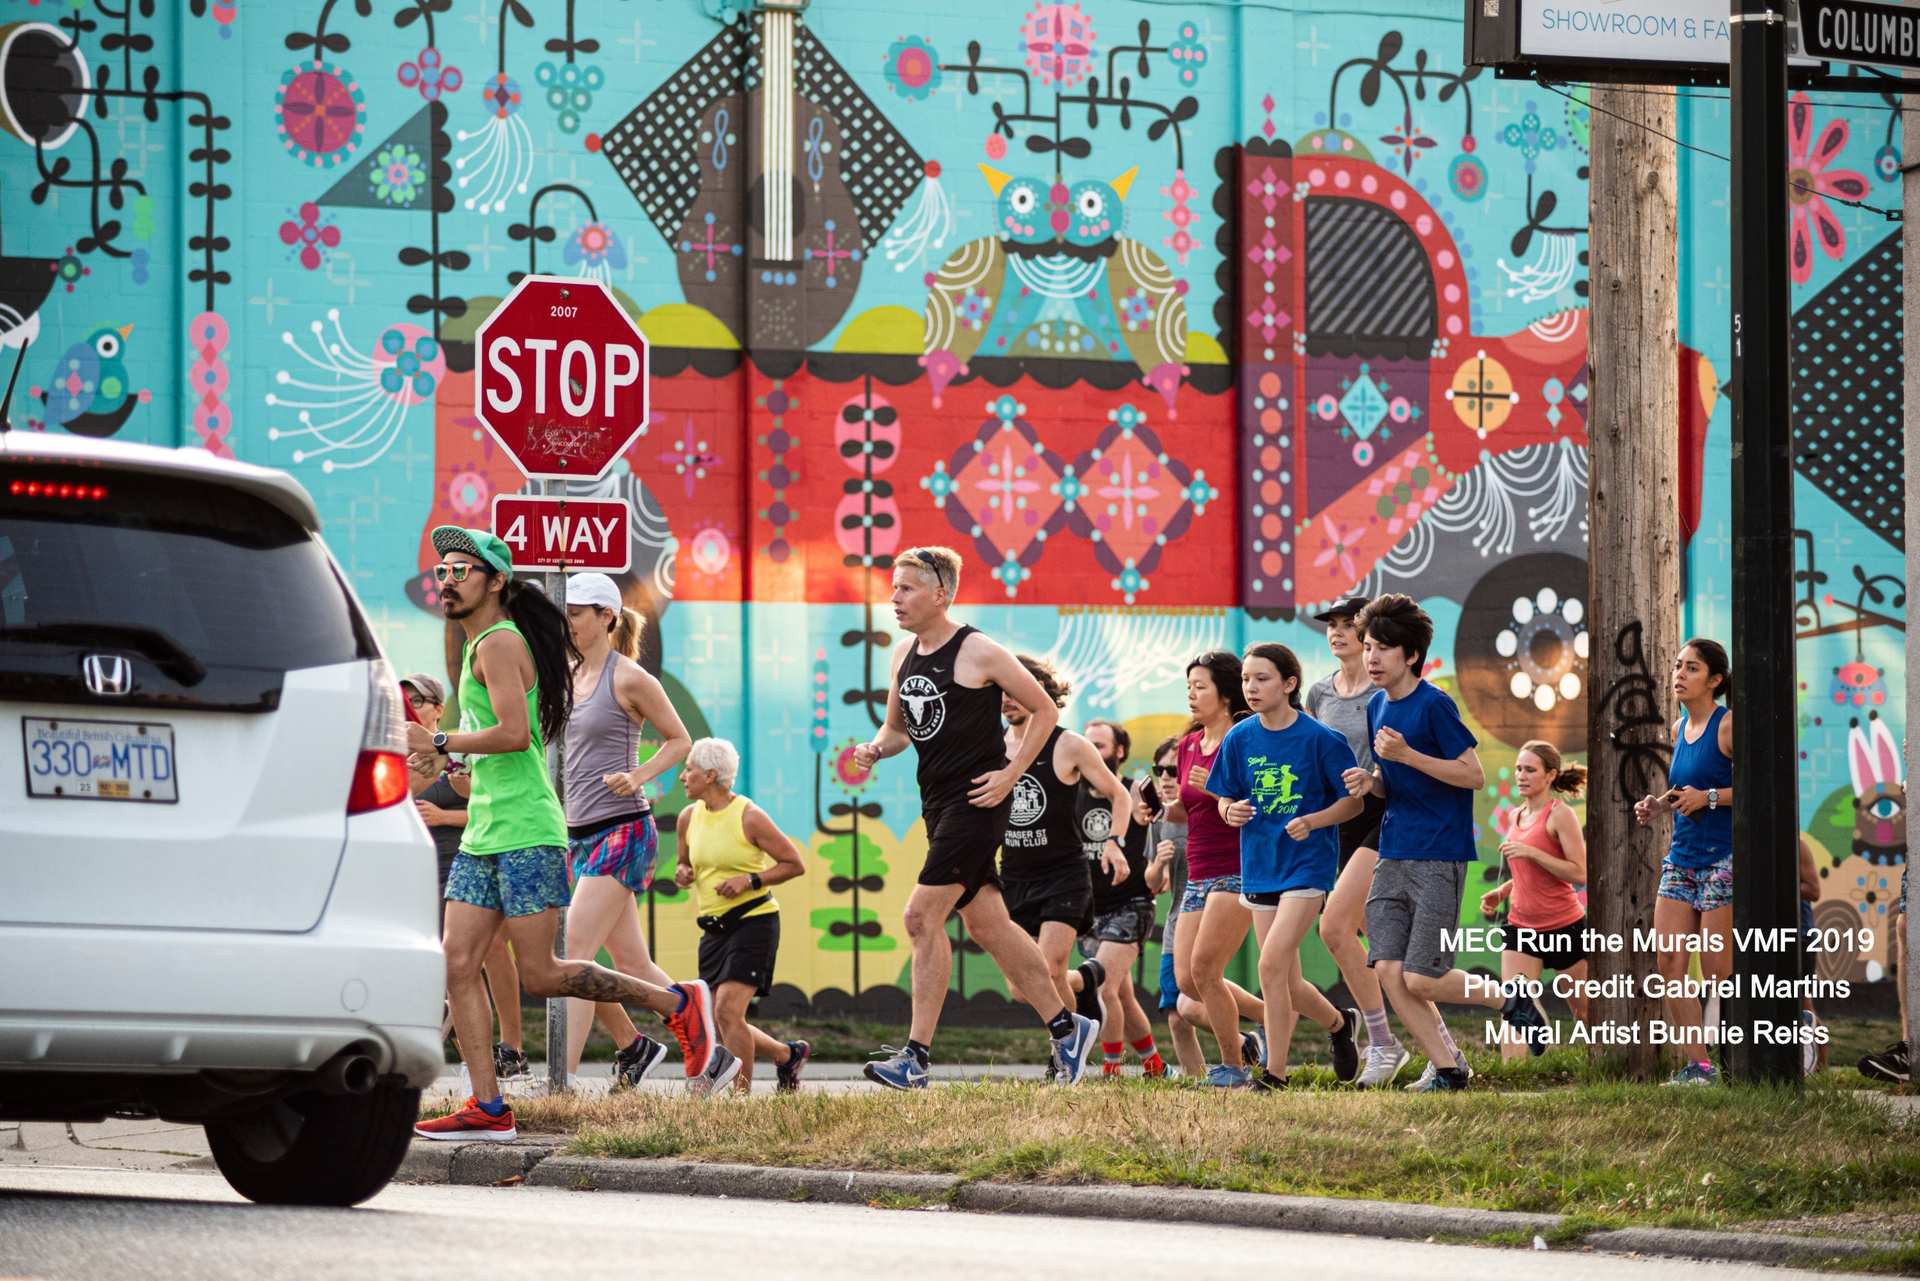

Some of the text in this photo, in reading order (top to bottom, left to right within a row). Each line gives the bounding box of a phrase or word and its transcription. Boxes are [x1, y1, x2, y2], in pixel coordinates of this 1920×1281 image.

[1543, 8, 1730, 41] SHOWROOM & FA
[550, 305, 578, 318] 2007
[486, 336, 640, 418] STOP
[503, 515, 619, 553] 4 WAY
[903, 679, 932, 694] EVRC
[32, 739, 171, 780] 330 MTD
[1023, 837, 1048, 848] CLUB
